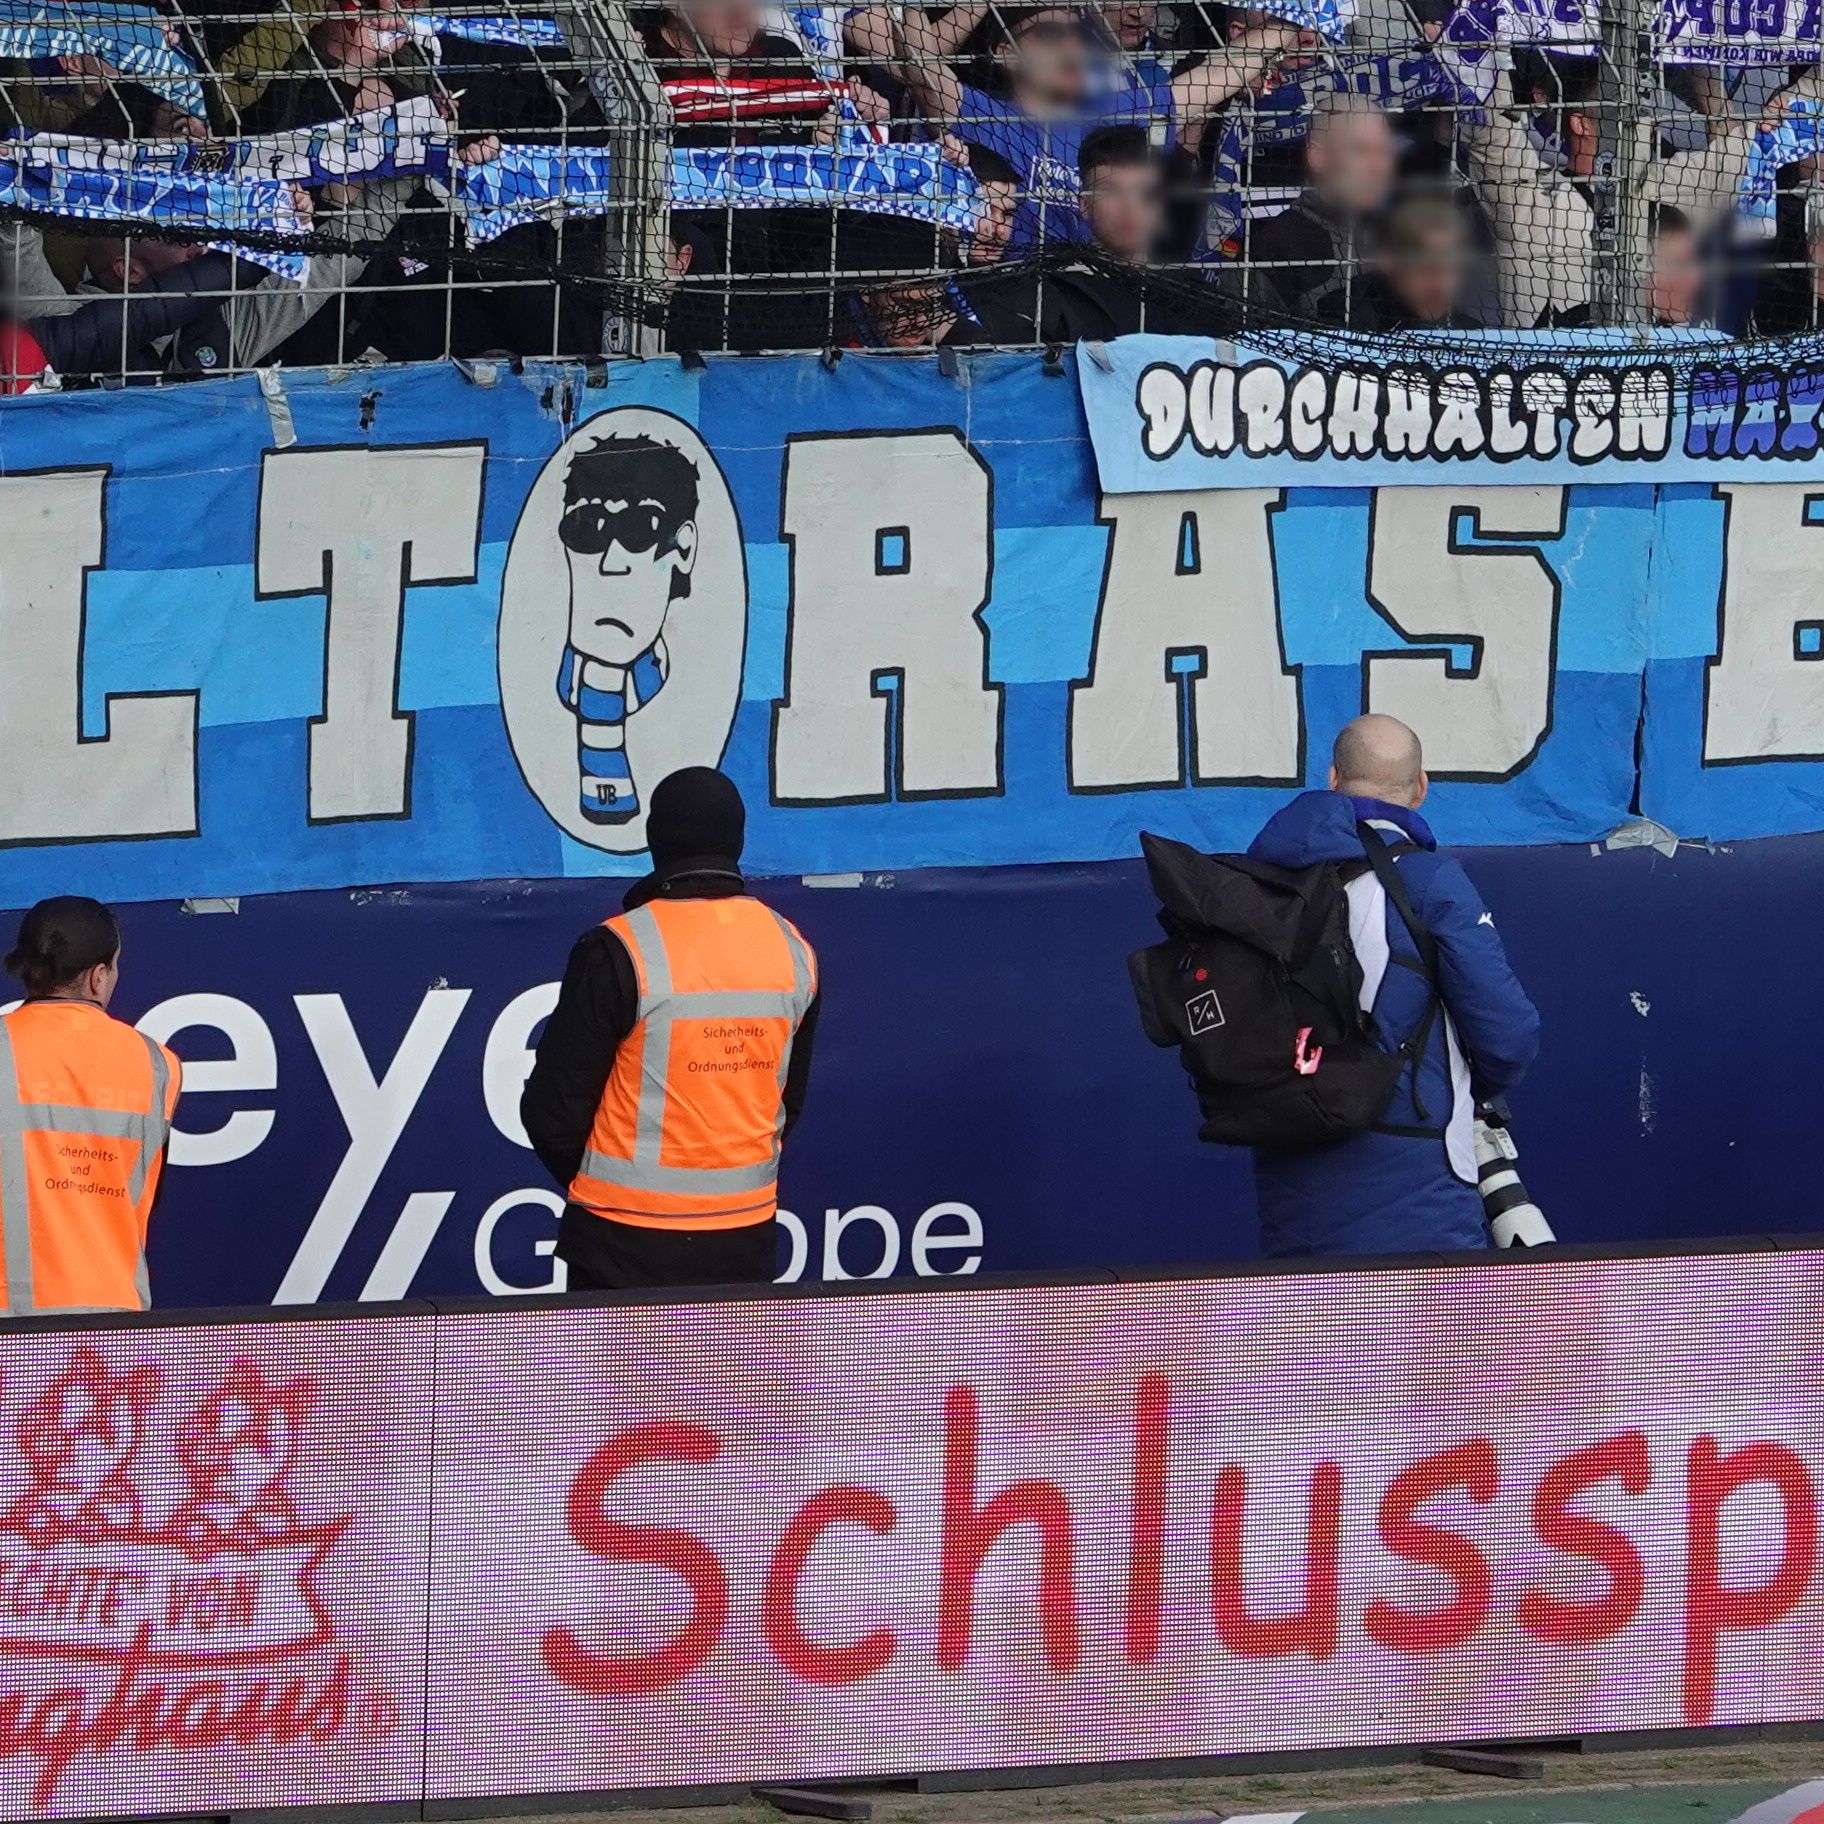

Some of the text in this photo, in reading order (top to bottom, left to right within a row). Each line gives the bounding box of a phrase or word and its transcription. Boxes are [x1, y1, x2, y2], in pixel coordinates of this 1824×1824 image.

[1138, 360, 1673, 461] DURCHHALTEN
[596, 780, 619, 808] UB
[703, 1025, 769, 1039] Sicherheits-
[724, 1043, 745, 1055] und
[687, 1059, 775, 1074] Ordnungsdienst
[70, 1164, 91, 1177] und
[165, 1574, 262, 1632] VON
